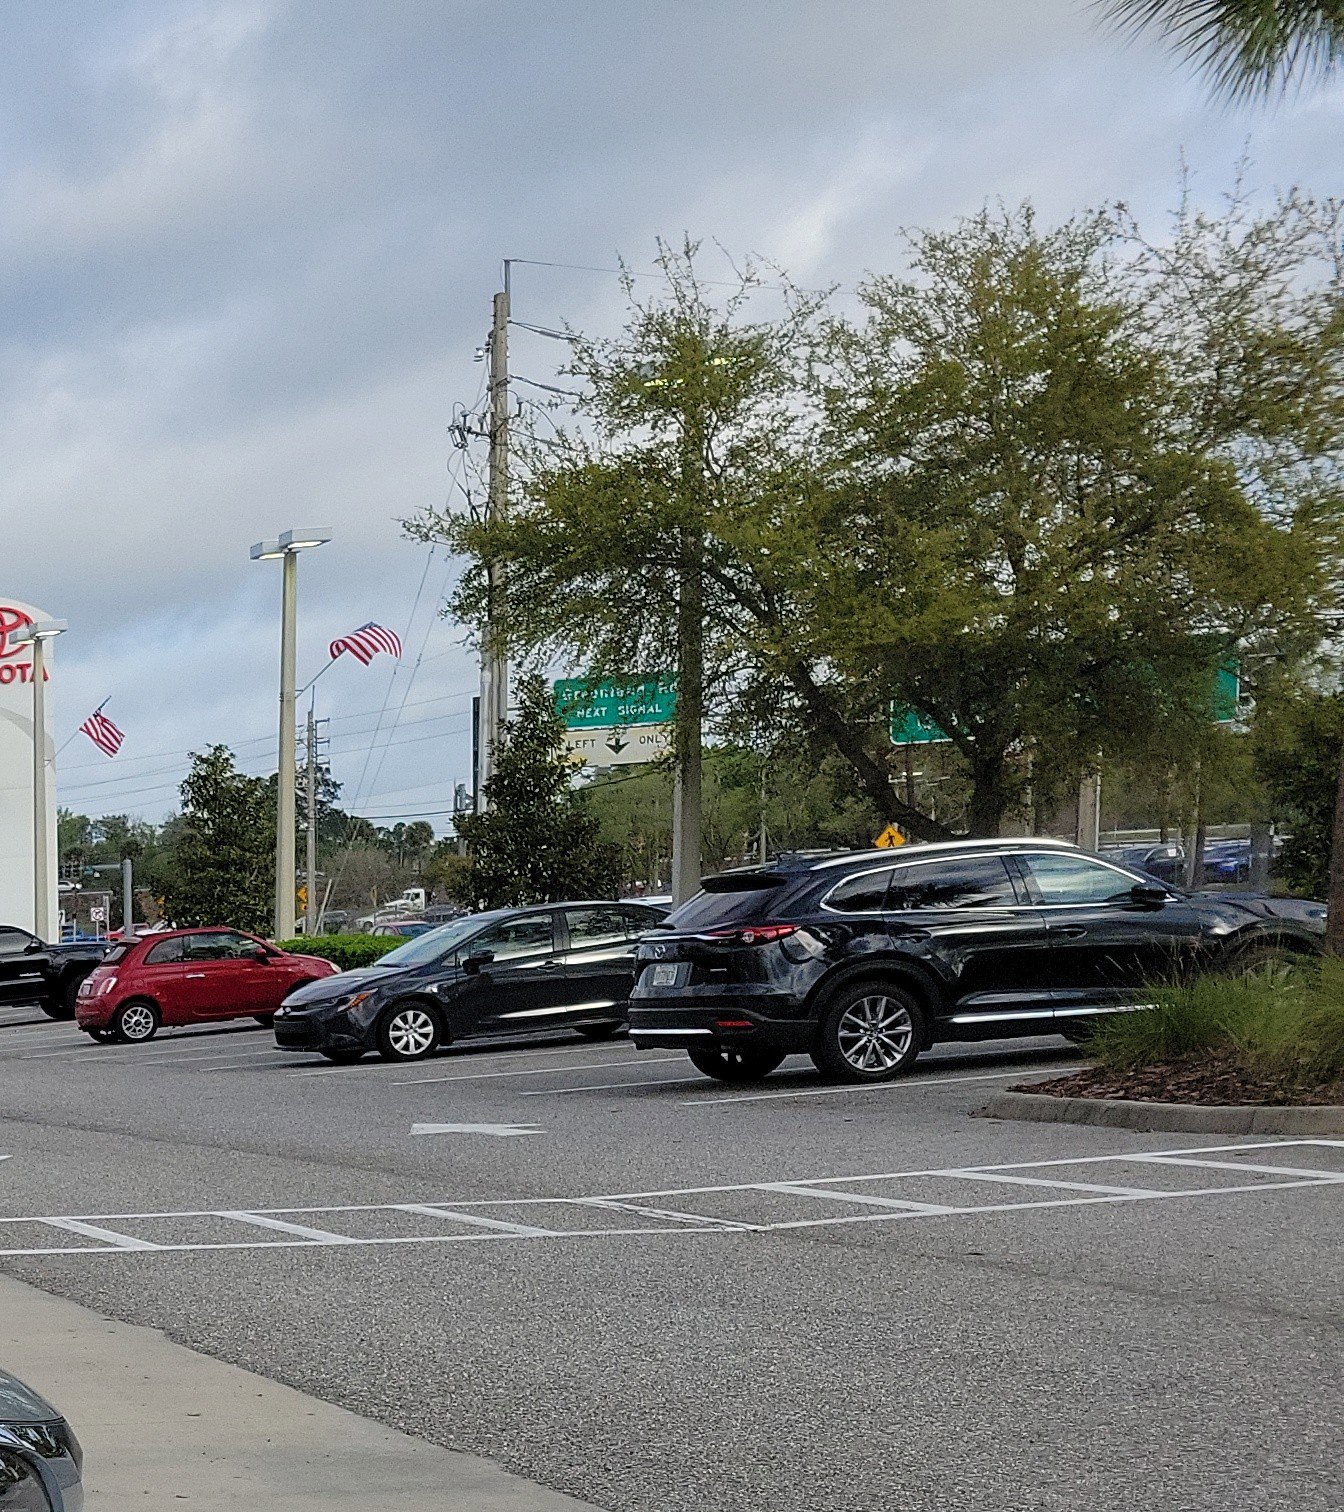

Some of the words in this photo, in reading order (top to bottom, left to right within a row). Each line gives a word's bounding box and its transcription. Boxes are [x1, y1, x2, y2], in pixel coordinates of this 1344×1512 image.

[576, 706, 608, 718] NEXT
[617, 703, 663, 716] SIGNAL
[639, 734, 670, 745] ONLY
